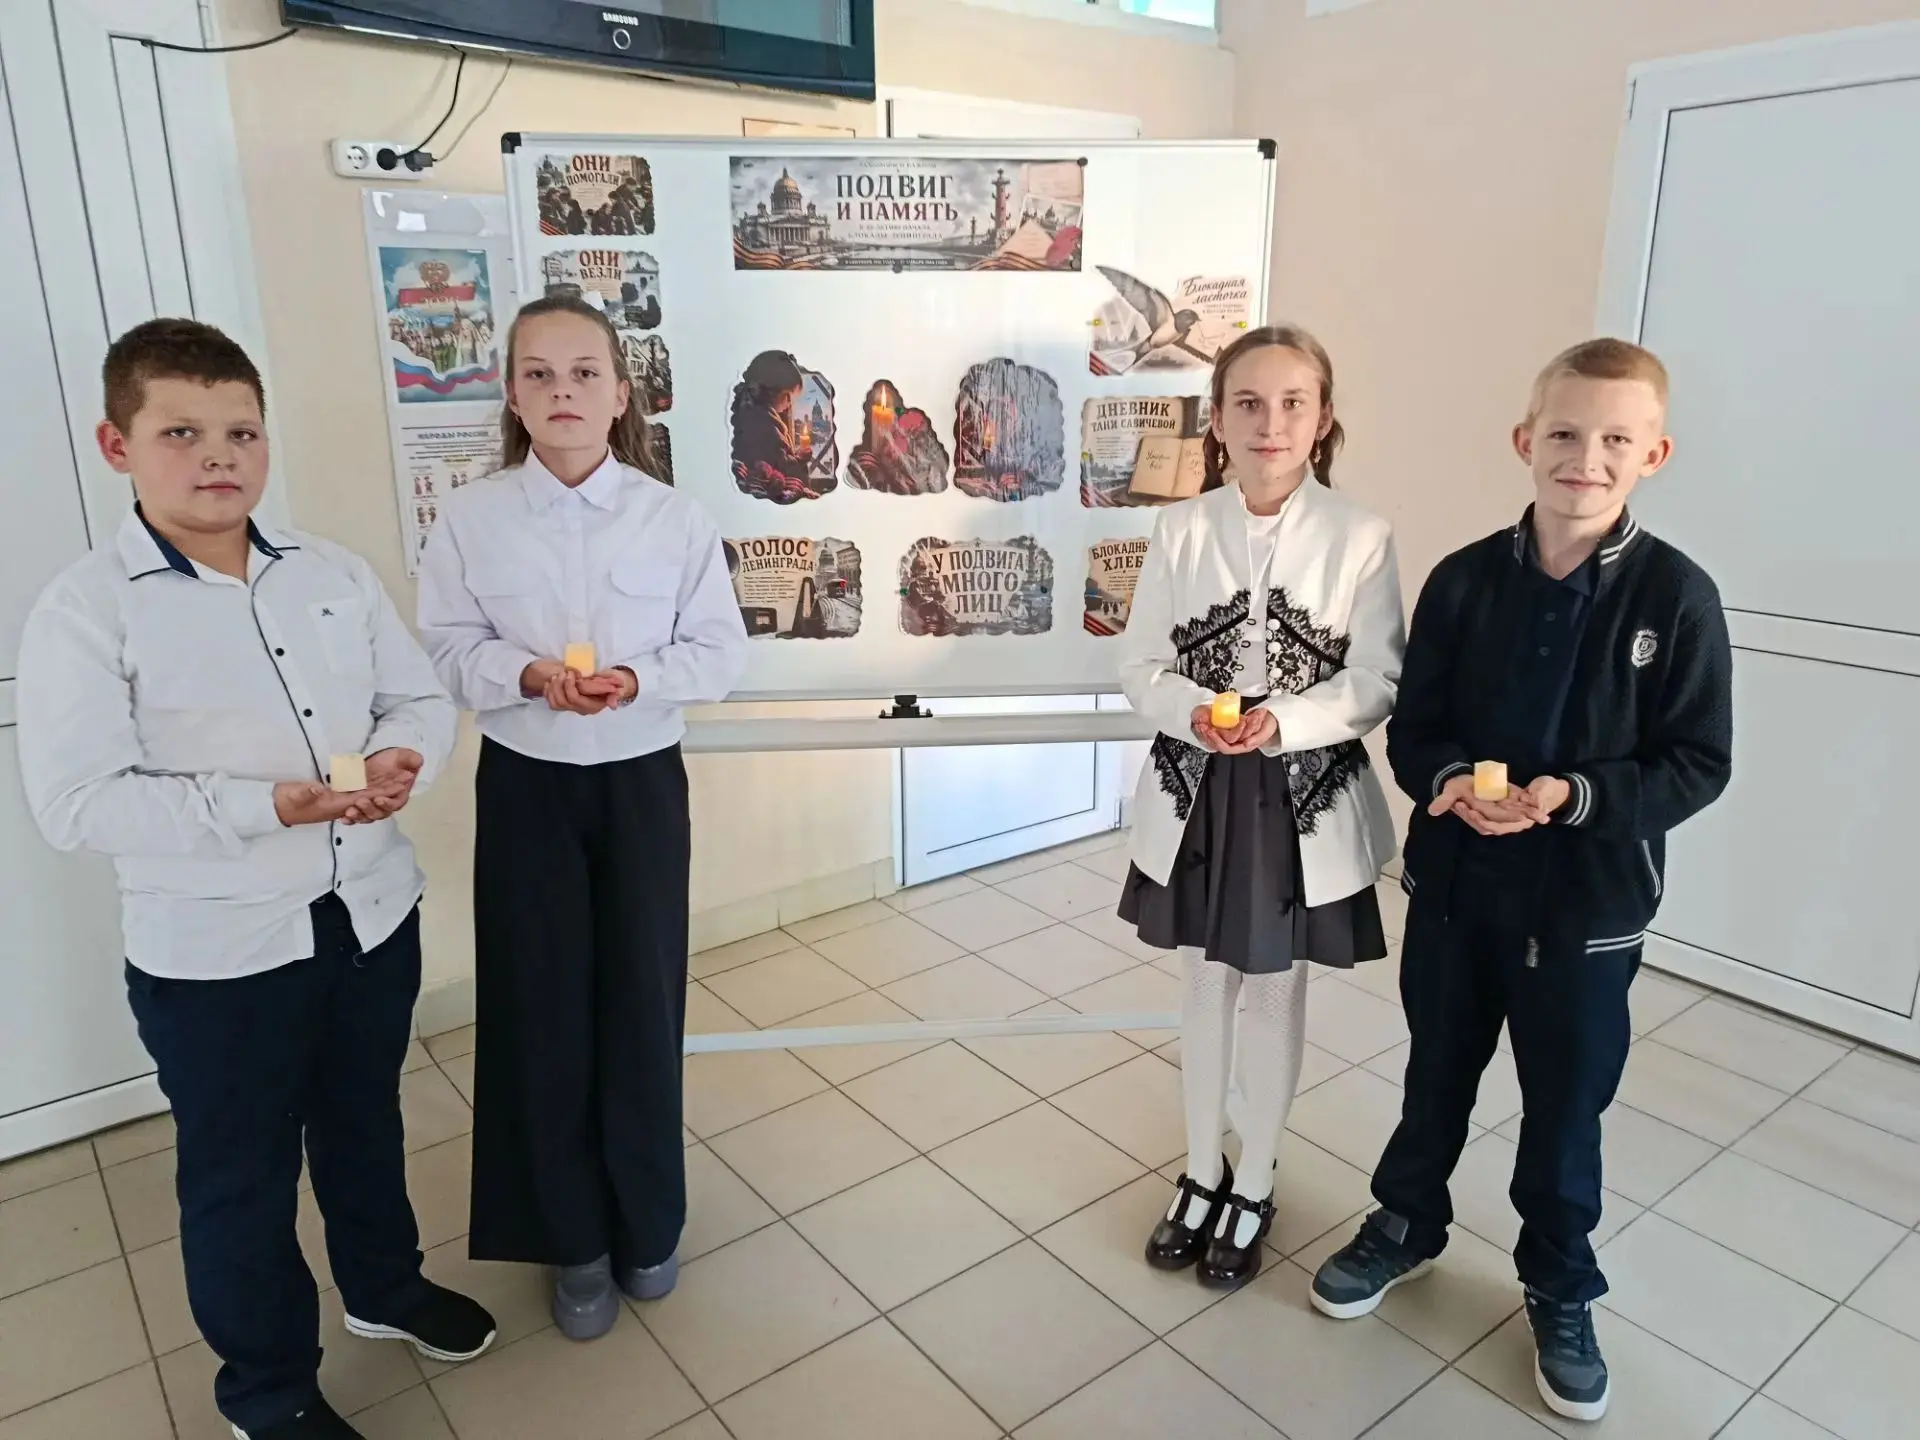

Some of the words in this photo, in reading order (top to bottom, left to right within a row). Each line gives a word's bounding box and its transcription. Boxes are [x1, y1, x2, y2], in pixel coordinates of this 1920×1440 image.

[602, 11, 639, 26] SAMSUNG
[572, 155, 611, 172] ОНИ
[566, 171, 621, 186] ПОМОГАЛИ
[837, 174, 953, 200] ПОДВИГ
[837, 202, 851, 220] И
[860, 202, 958, 220] ПАМЯТЬ
[579, 250, 620, 267] ОНИ
[579, 267, 622, 280] ВЕЗЛИ
[1183, 276, 1245, 296] Блокадная
[1192, 289, 1248, 304] ласточка
[1096, 401, 1171, 419] ДНЕВНИК
[1091, 419, 1118, 432] ТАНИ
[1120, 418, 1176, 430] САВИЧЕВОЙ
[740, 539, 809, 559] ГОЛОС
[742, 557, 815, 573] ЛЕНИНГРАДА
[932, 552, 943, 573] У
[949, 549, 1024, 571] ПОДВИГА
[1103, 555, 1144, 571] ХЛЕБ
[942, 571, 1019, 594] МНОГО
[954, 594, 1003, 615] ЛИЦ
